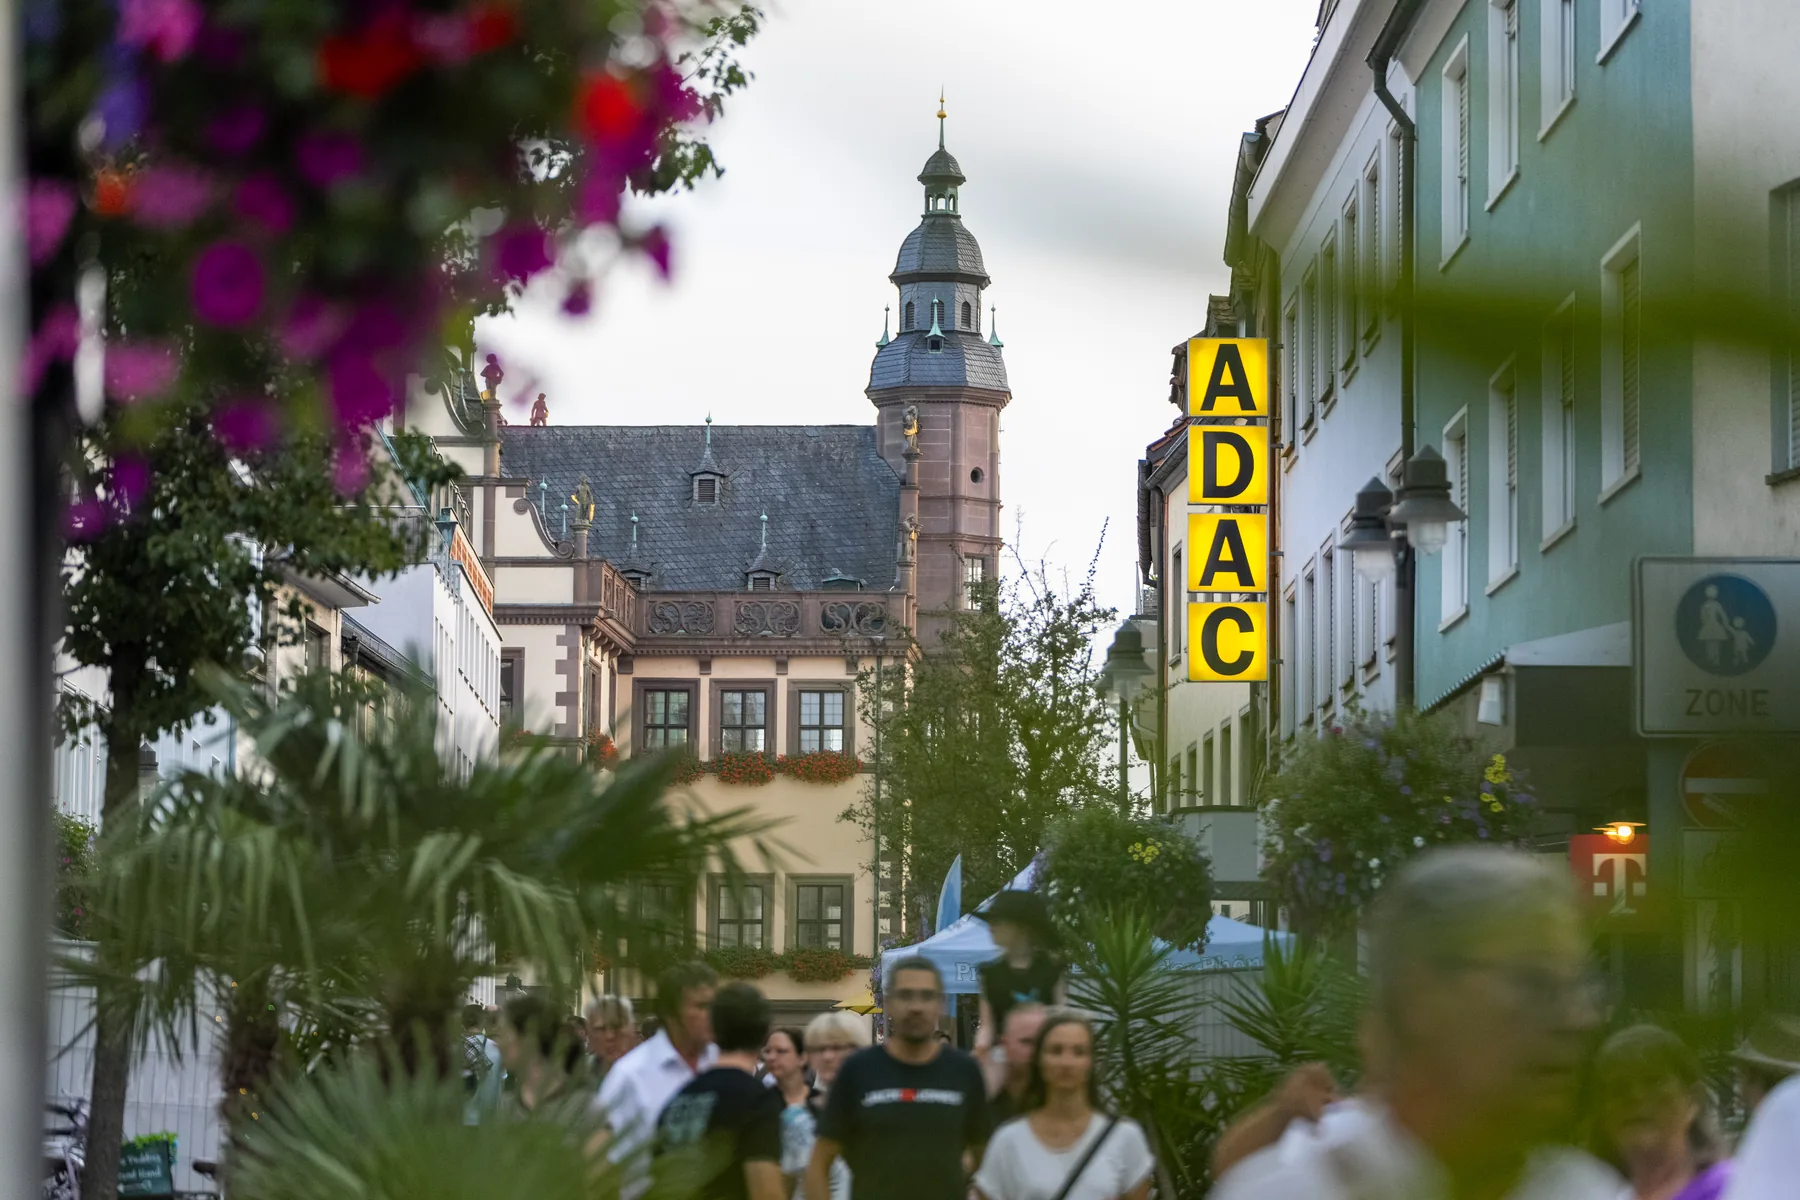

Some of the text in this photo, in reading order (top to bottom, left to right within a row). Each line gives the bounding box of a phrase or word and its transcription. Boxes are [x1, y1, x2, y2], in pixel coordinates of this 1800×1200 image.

[1199, 342, 1257, 677] ADAC
[1685, 688, 1770, 717] ZONE
[1593, 853, 1647, 914] T
